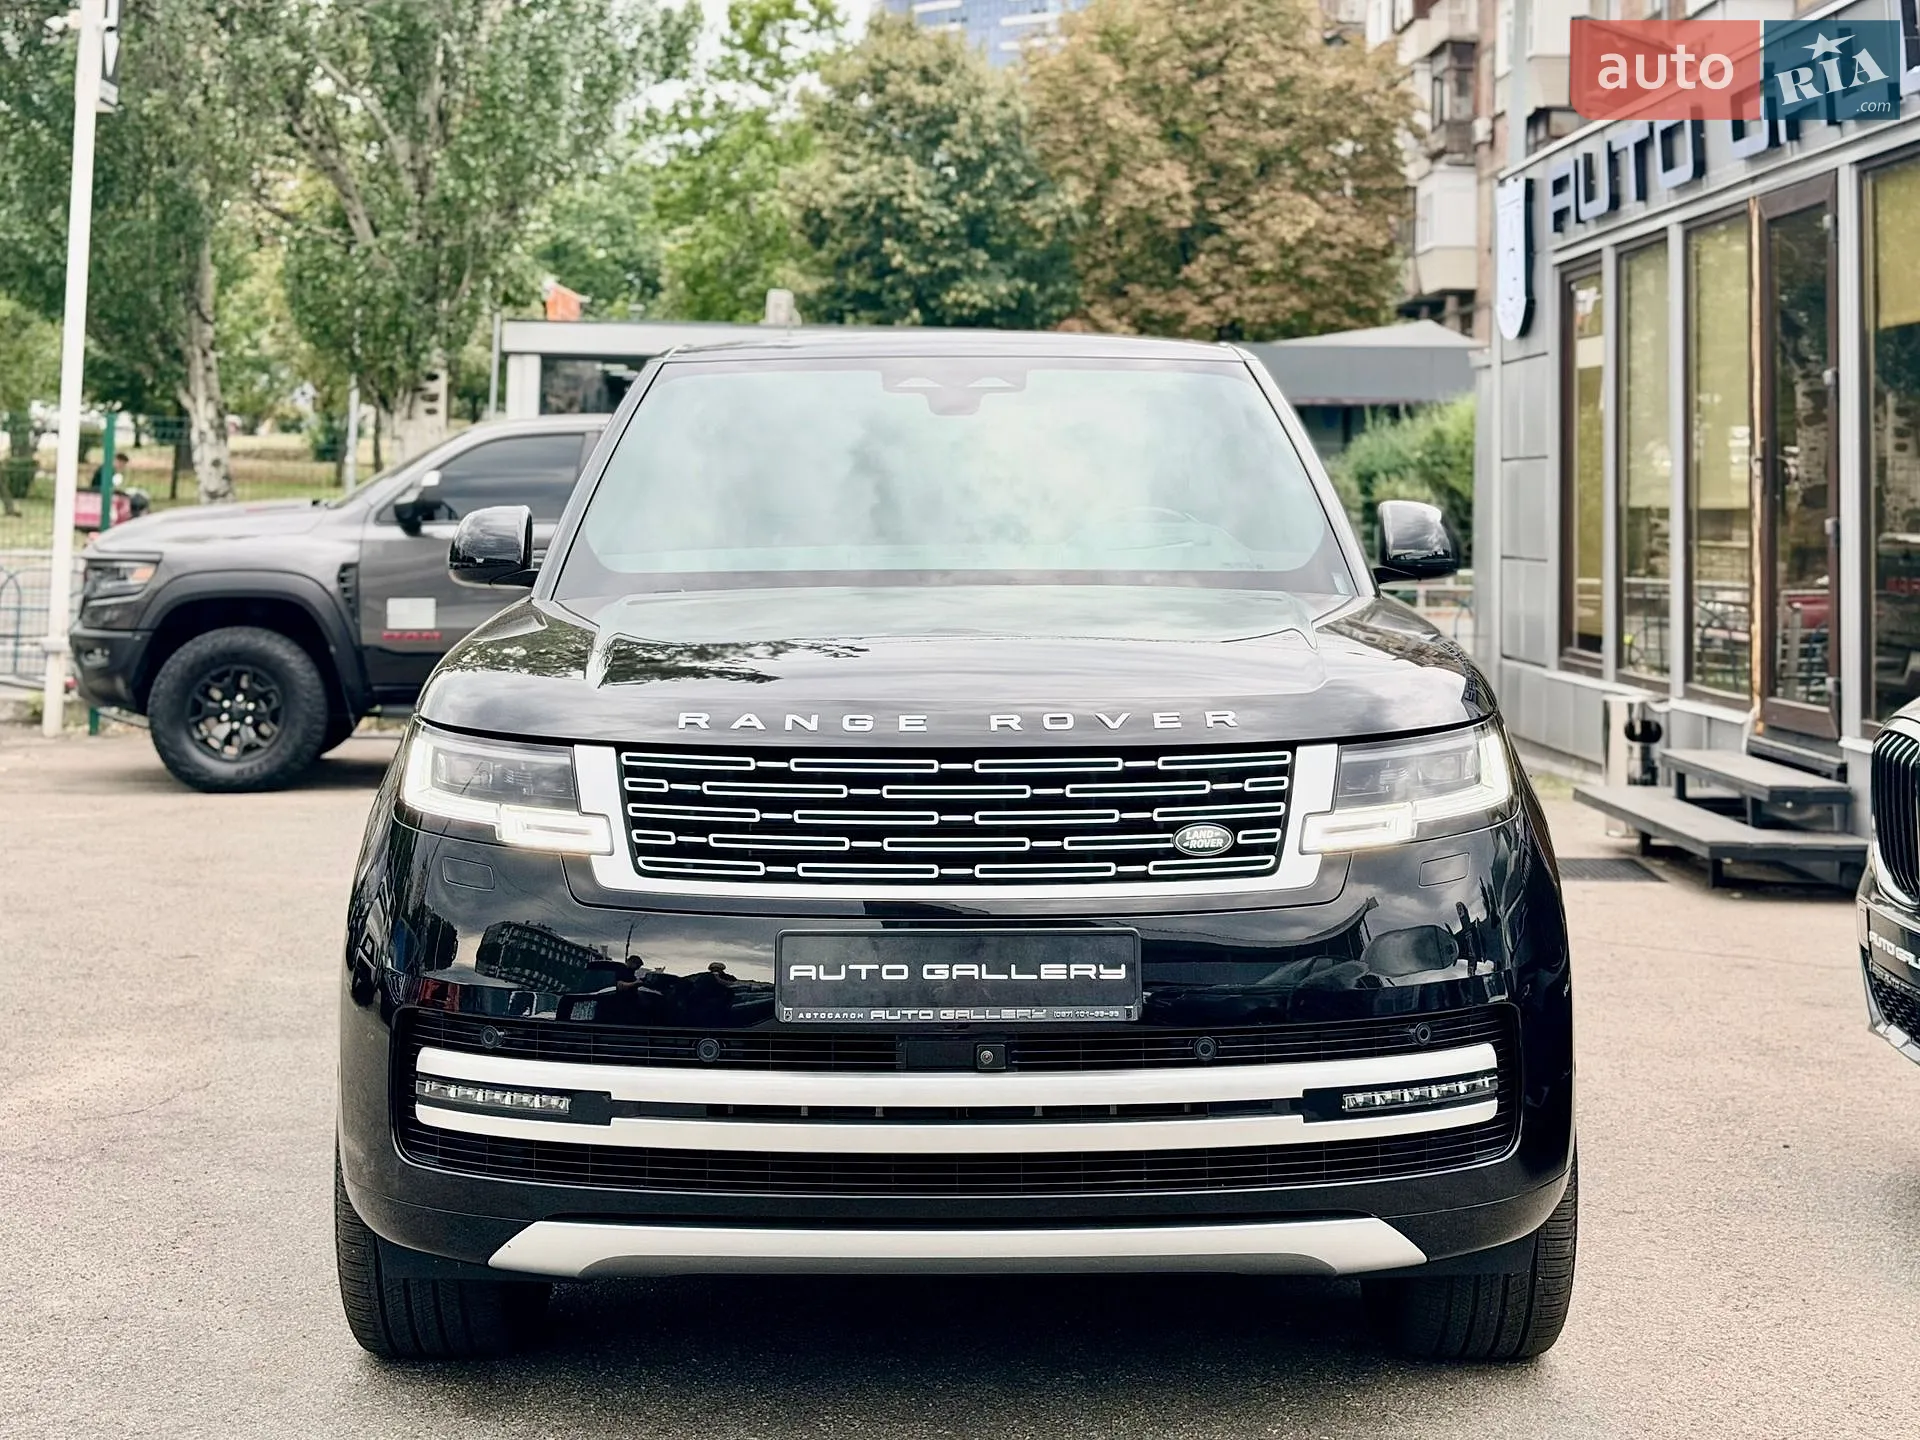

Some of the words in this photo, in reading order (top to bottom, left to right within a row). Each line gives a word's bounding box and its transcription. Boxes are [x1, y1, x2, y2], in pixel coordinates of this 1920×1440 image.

[678, 712, 928, 732] RANGE
[989, 710, 1239, 732] ROVER
[1185, 830, 1214, 840] LAND
[1189, 838, 1224, 849] ROVER
[789, 964, 909, 980] AUTO
[922, 963, 1126, 980] GALLERY
[870, 1009, 934, 1019] AUTO
[939, 1009, 1046, 1019] GALLERY
